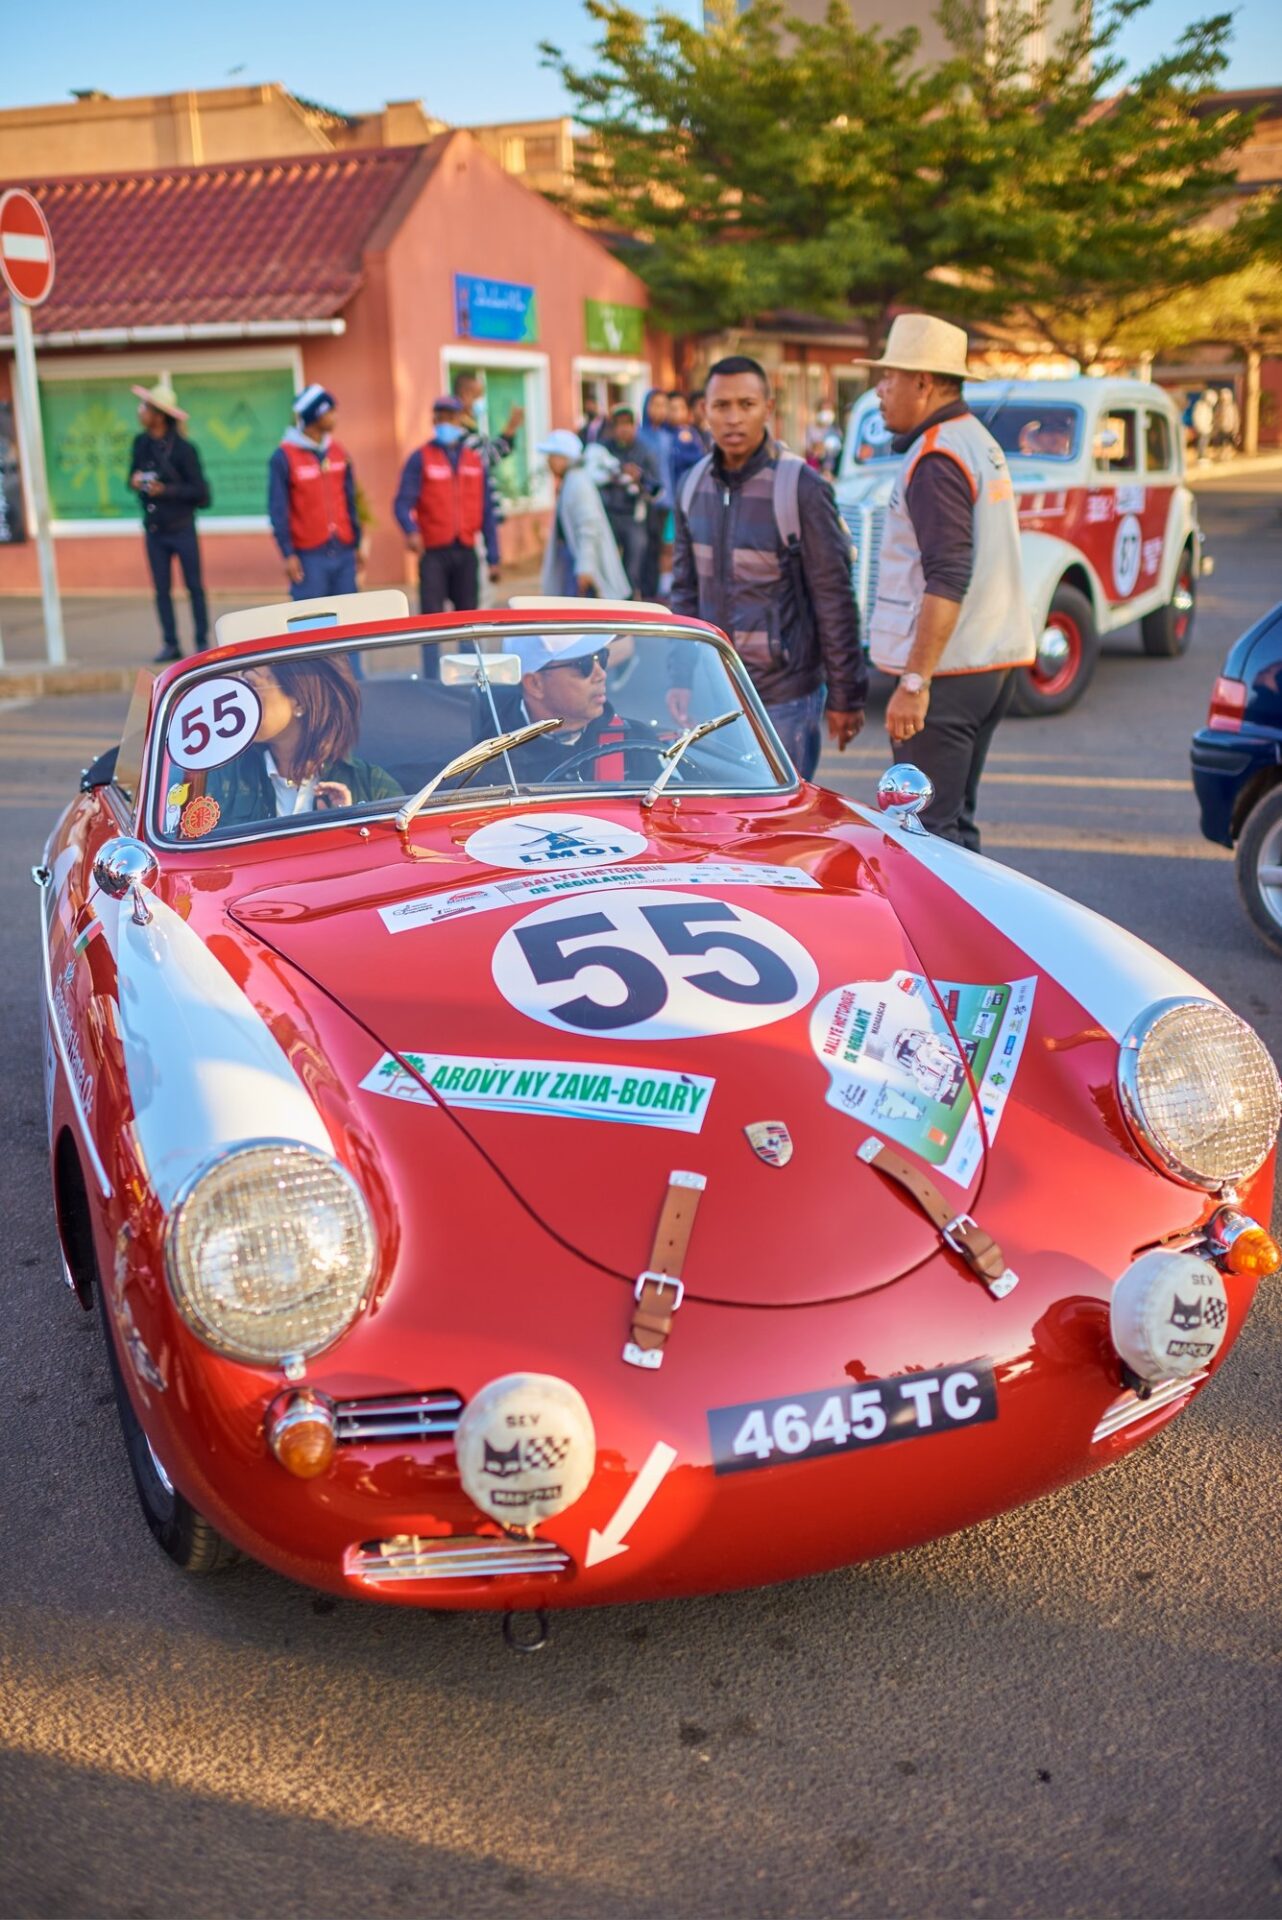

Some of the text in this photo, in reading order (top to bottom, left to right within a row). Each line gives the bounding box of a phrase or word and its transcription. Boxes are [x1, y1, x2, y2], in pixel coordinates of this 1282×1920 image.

[180, 690, 246, 755] 55
[519, 846, 624, 863] LMOI
[522, 865, 667, 887] RALLYE HISTORIQUE
[529, 886, 550, 895] DE
[512, 902, 798, 1030] 55
[823, 990, 856, 1056] RALLYE HISTORIQUE
[871, 1001, 887, 1035] MADAGASCAR
[843, 1051, 858, 1063] DE
[430, 1065, 706, 1114] AROVY NY ZAVA-BOARY
[1191, 1273, 1214, 1286] SEV
[505, 1413, 541, 1428] SEV
[732, 1372, 981, 1459] 4645 TC
